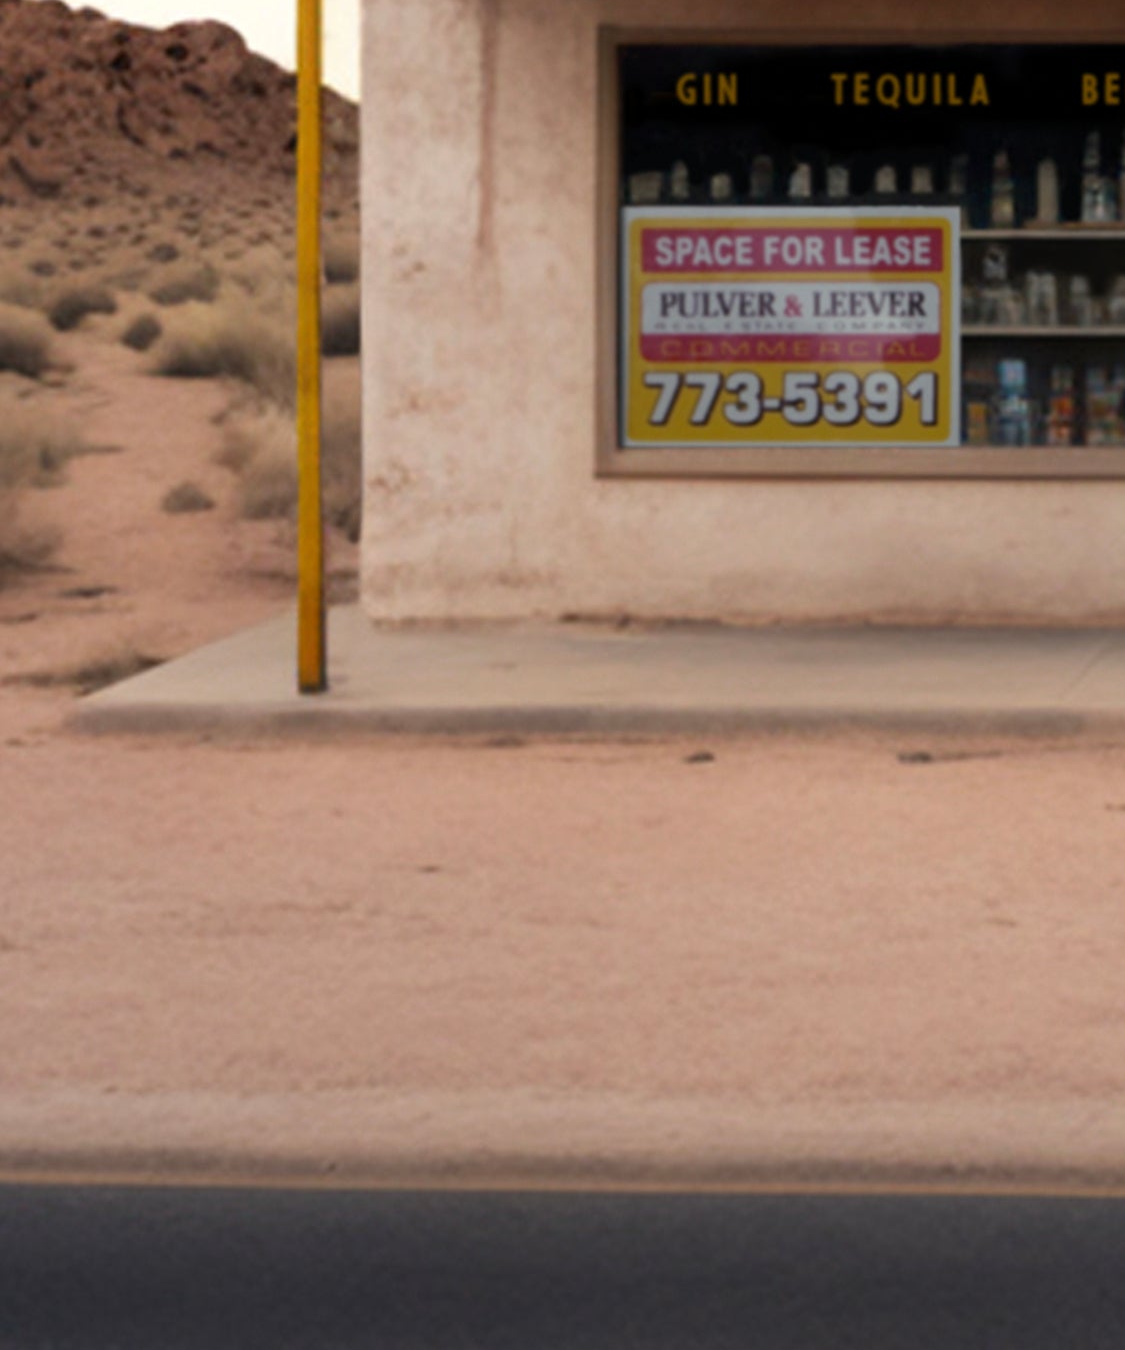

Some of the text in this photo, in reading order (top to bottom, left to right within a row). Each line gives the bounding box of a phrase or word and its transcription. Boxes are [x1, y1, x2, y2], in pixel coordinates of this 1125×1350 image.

[675, 73, 739, 106] GIN
[831, 73, 991, 107] TEQUILA
[655, 236, 931, 266] SPACE FOR LEASE
[660, 290, 926, 319] PULVER & LEEVER
[661, 339, 927, 358] COMMERCIAL
[643, 371, 939, 425] 773-5391
